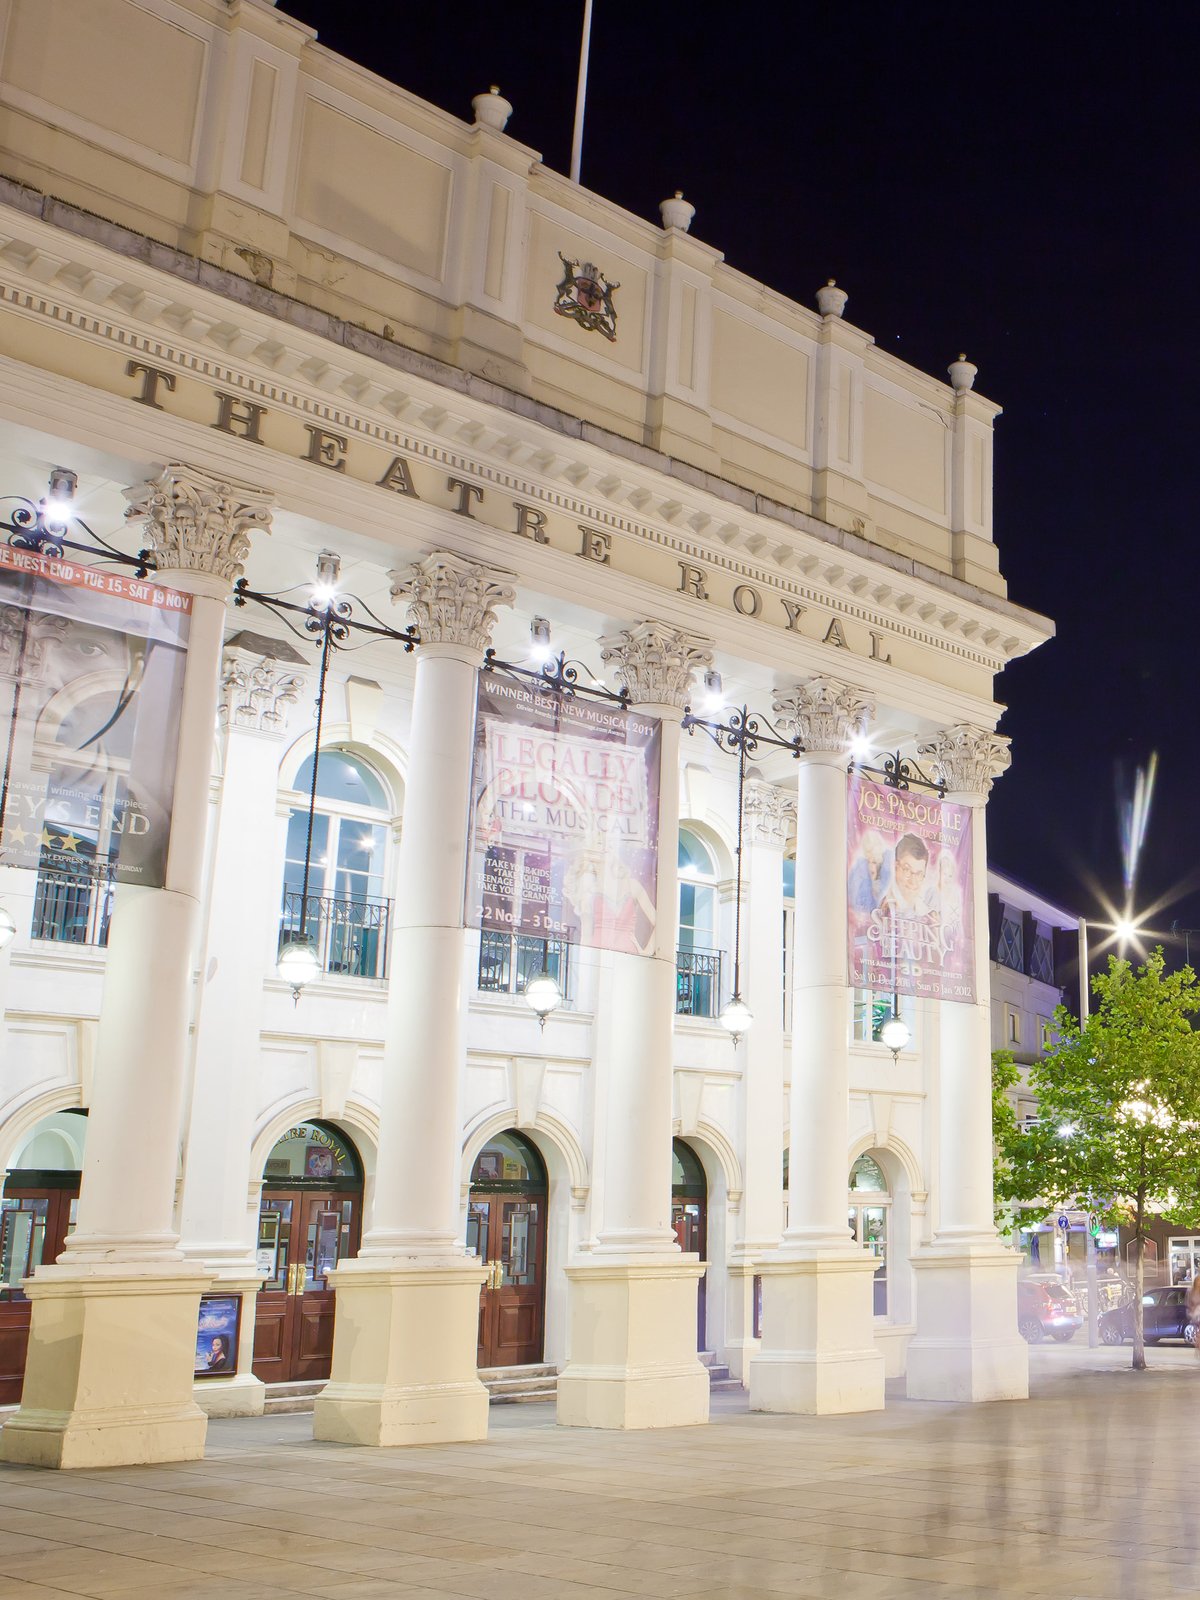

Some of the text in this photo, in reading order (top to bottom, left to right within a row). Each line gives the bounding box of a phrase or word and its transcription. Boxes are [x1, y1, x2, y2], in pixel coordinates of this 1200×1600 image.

[125, 359, 612, 567] THEATRE
[12, 552, 48, 574] WEST
[50, 563, 74, 581] END
[83, 571, 104, 589] TUE
[152, 590, 165, 605] 19
[166, 594, 190, 610] NOV
[676, 561, 892, 665] ROYAL
[485, 682, 654, 737] WINNER! BEST NEW MUSICAL 2011
[495, 733, 636, 784] LEGALLY
[51, 786, 90, 801] winning
[93, 792, 149, 810] maerpiece
[497, 767, 637, 816] BLONDE
[858, 785, 962, 831] JOE PASQUALE
[84, 804, 151, 836] END
[497, 799, 639, 835] THE MUSICAL
[53, 852, 85, 865] EXPRESS
[509, 863, 531, 875] YOR
[519, 874, 540, 885] OUR
[475, 905, 493, 920] 22
[533, 914, 542, 928] 3
[543, 916, 568, 932] Dec
[917, 981, 932, 992] Sun
[954, 985, 972, 997] 2012
[311, 1129, 347, 1166] ROYAL
